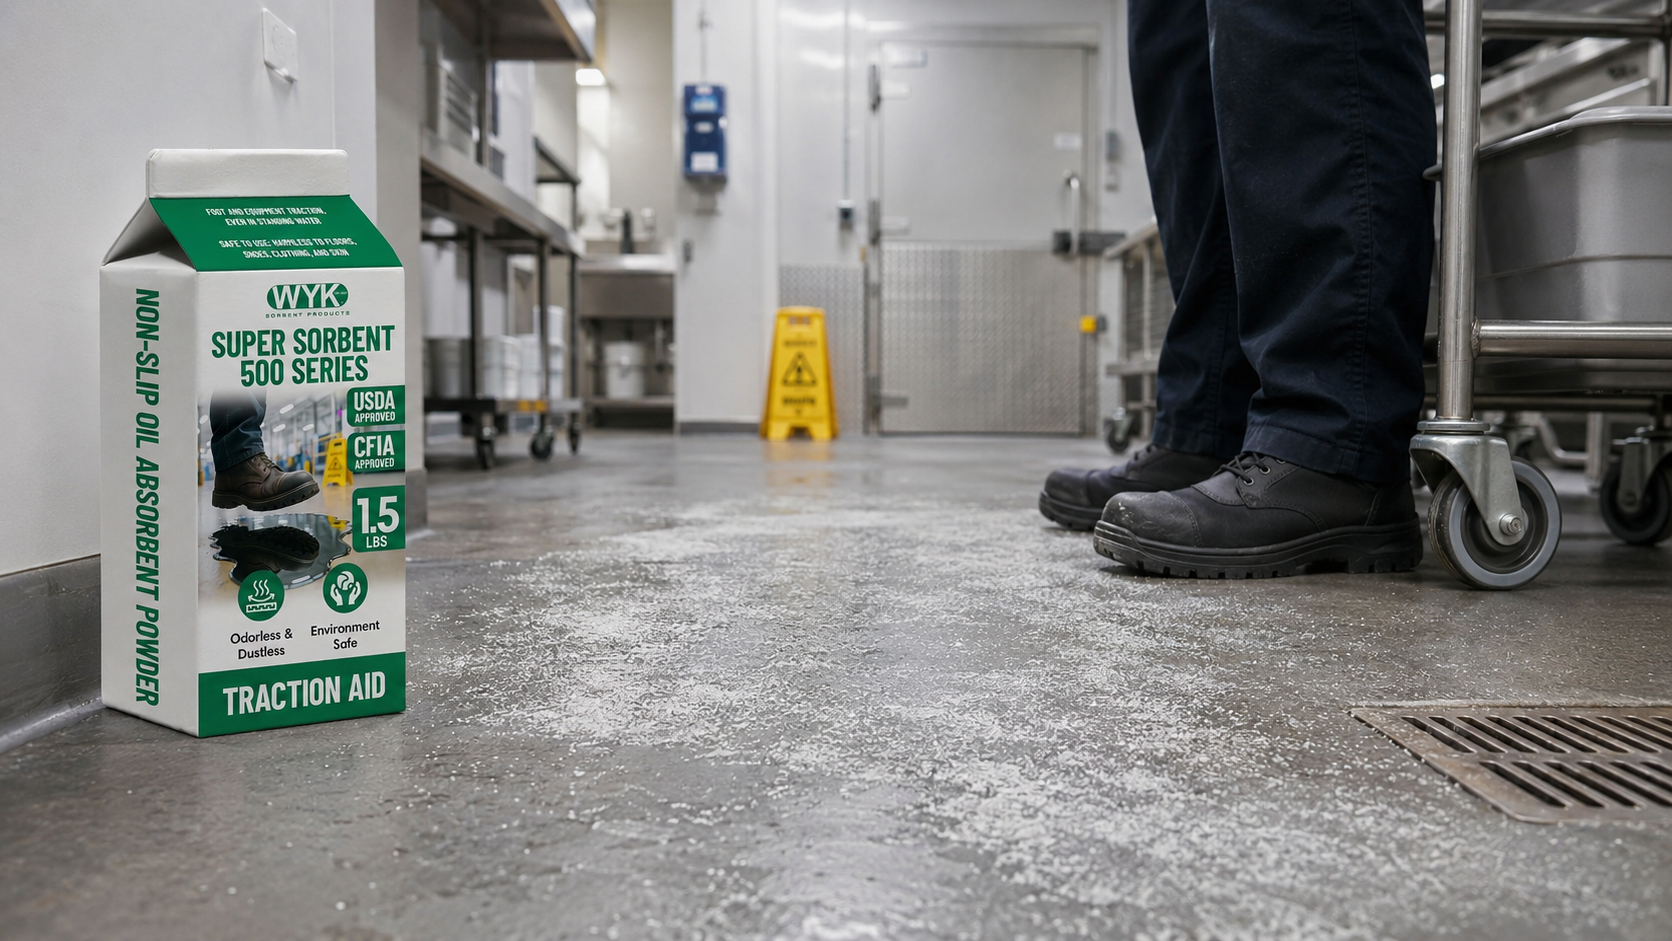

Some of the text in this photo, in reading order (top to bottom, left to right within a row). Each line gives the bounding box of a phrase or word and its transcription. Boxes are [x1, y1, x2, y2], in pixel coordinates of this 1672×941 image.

[205, 208, 226, 216] FOOT
[243, 207, 286, 216] EQUIPMENT
[225, 218, 247, 226] EVEN
[247, 218, 257, 226] IN
[256, 217, 295, 226] STANDING
[218, 240, 242, 248] SAFE
[271, 238, 313, 247] HARMLESS
[312, 238, 325, 246] TO
[313, 249, 330, 257] AND
[329, 248, 350, 257] SKIN
[272, 283, 340, 309] WYK
[211, 325, 395, 358] SUPER SORBENT
[240, 355, 369, 387] 500 SERIES
[354, 390, 395, 411] USDA
[354, 411, 396, 424] APPROVED
[354, 434, 395, 458] CFIA
[354, 458, 395, 470] APPROVED
[135, 288, 160, 707] NON-SLIP OIL ABSORBENT POWDER
[357, 495, 400, 534] 1.5
[366, 535, 388, 549] LBS
[230, 628, 293, 645] Odorless &
[310, 620, 380, 637] Environment
[333, 637, 358, 650] Safe
[238, 646, 285, 660] Dustless
[222, 671, 386, 716] TRACTION AID
